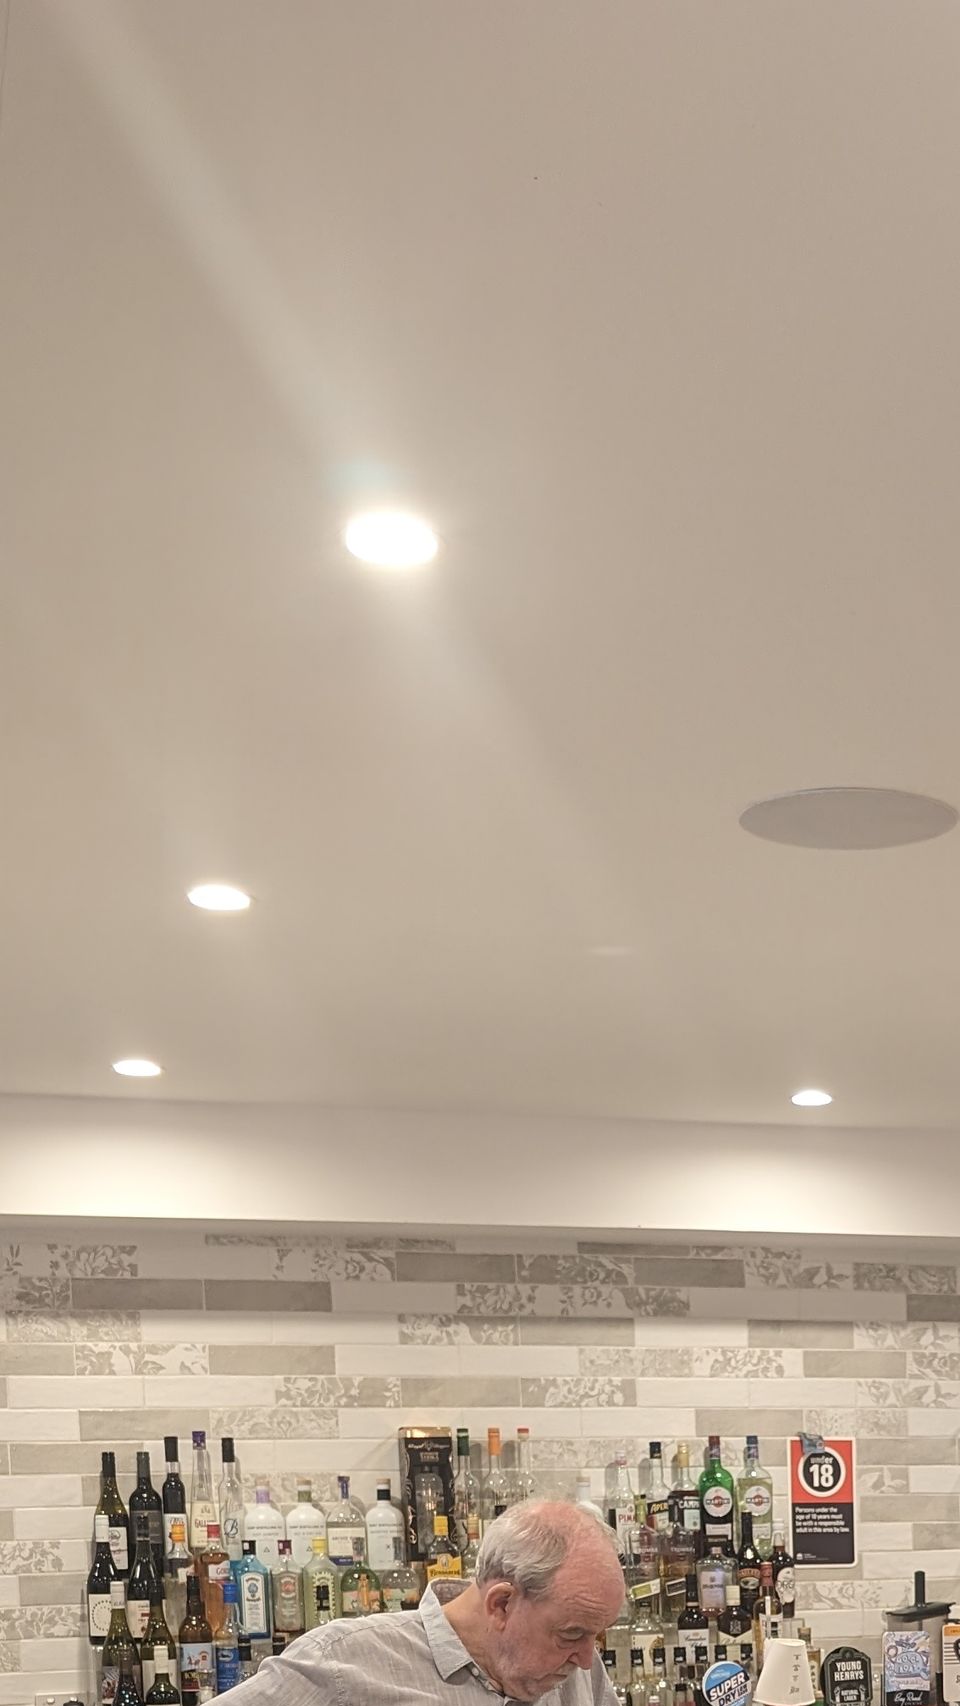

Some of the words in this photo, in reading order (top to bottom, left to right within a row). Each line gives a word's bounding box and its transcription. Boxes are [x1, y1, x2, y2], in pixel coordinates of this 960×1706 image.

[810, 1456, 834, 1464] under
[808, 1463, 834, 1488] 18
[835, 1660, 862, 1672] YOUNG
[834, 1670, 864, 1682] HENRYS
[709, 1671, 746, 1701] SUPER
